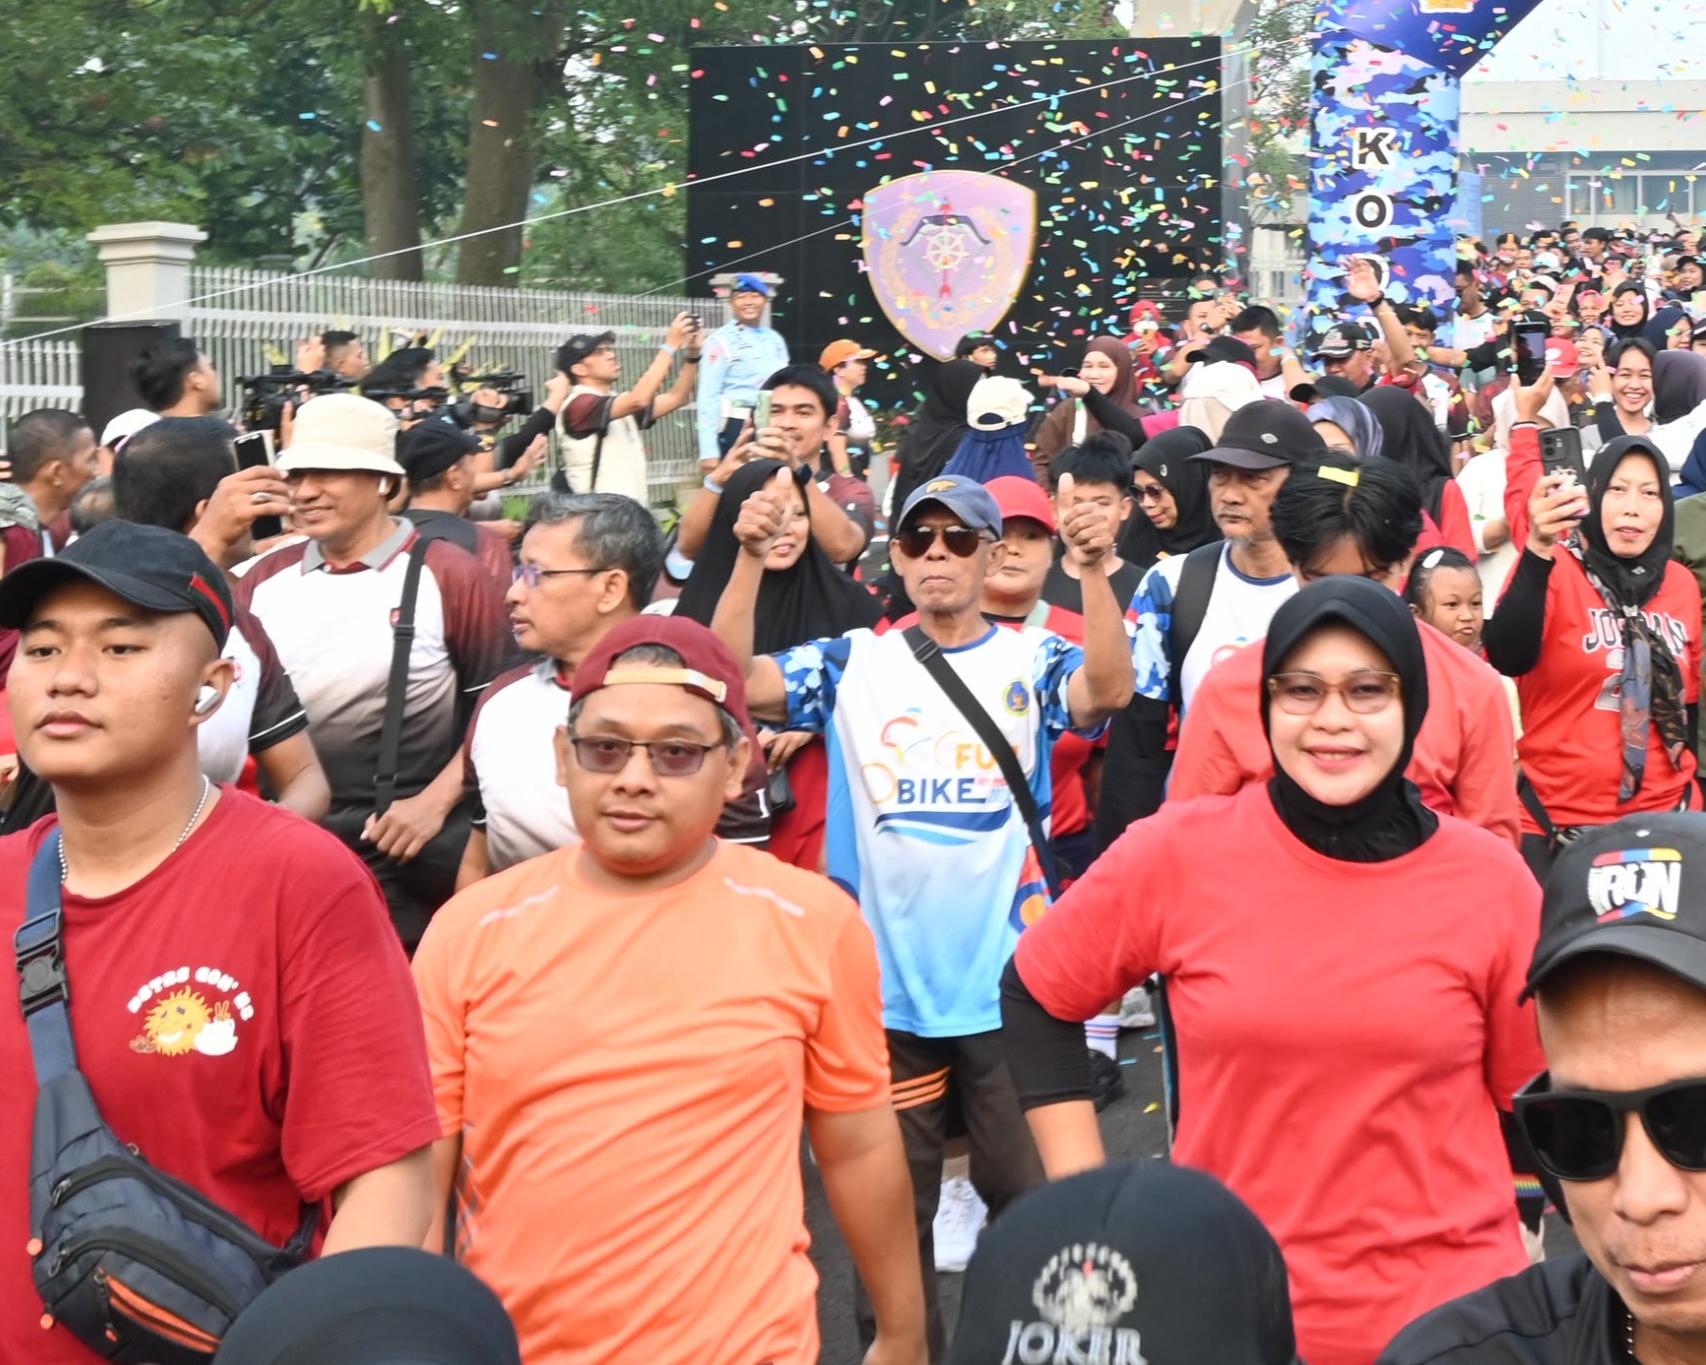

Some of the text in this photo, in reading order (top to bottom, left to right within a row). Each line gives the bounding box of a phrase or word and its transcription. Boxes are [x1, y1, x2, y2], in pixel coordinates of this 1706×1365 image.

[955, 743, 1020, 770] FU
[897, 777, 986, 804] BIKE
[1599, 862, 1682, 915] RUN
